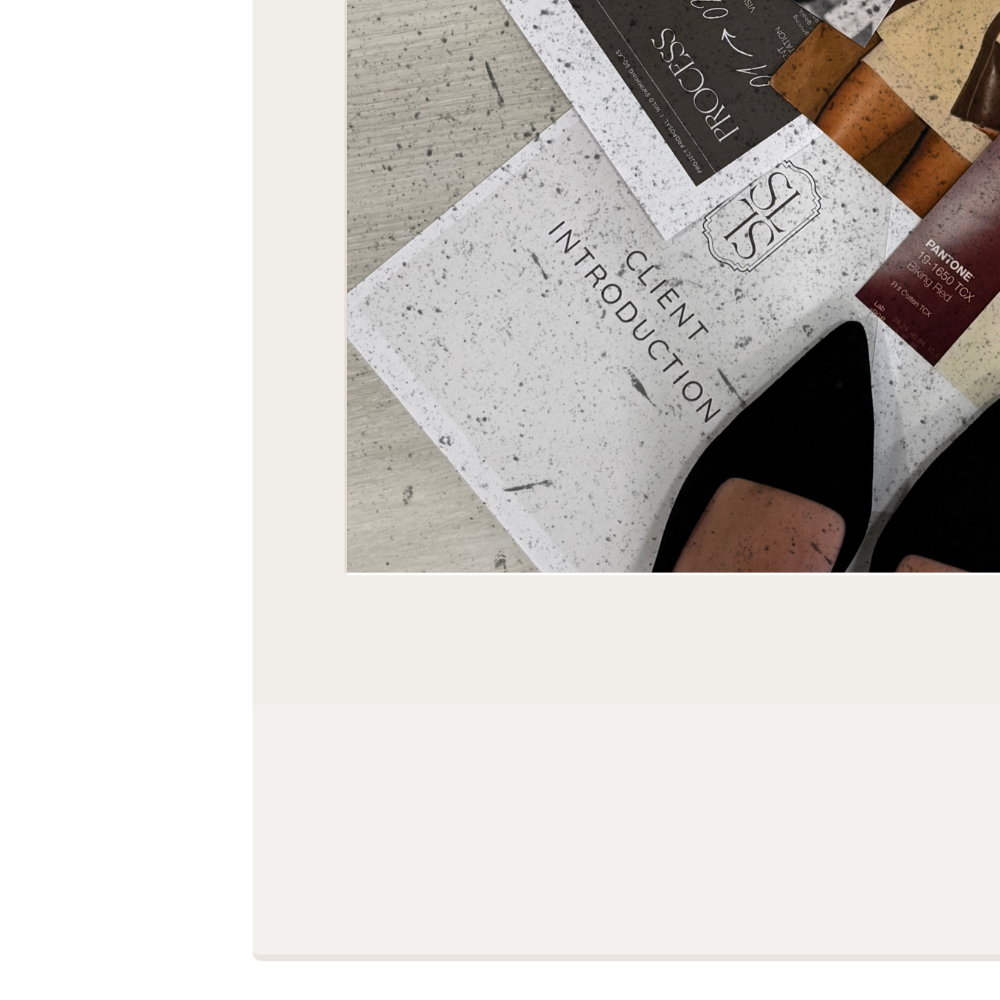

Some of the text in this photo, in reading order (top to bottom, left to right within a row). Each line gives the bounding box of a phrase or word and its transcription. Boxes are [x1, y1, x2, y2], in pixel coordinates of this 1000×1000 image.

[650, 28, 739, 143] PROCESS
[735, 64, 771, 88] 01
[615, 49, 703, 174] PROJECT PROPOSAL WILD SWIMMING SOCKS
[906, 260, 953, 303] Biking Red
[917, 250, 975, 303] 19-1650 TCX
[925, 238, 973, 282] PANTONE
[626, 250, 709, 340] CLIENT
[873, 300, 886, 312] Lab
[900, 289, 920, 308] Cotton
[919, 304, 932, 318] TCX
[548, 220, 721, 423] INTRODUCTION
